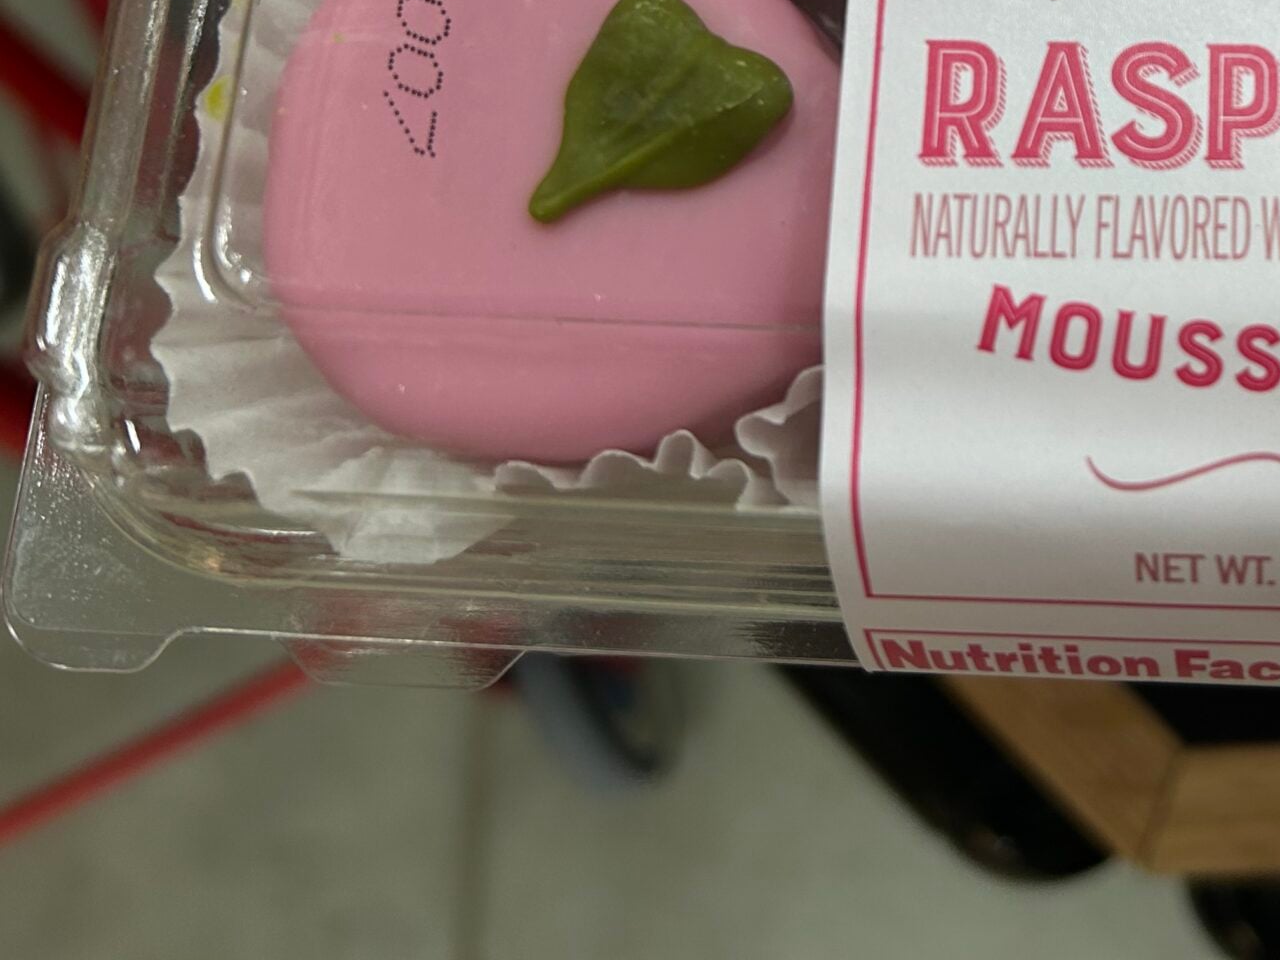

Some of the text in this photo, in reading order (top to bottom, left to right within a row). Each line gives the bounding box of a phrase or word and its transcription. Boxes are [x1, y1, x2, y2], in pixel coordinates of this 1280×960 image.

[910, 192, 1087, 261] NATURALLY
[1096, 195, 1252, 262] FLAVORED
[1134, 553, 1203, 585] NET
[1216, 555, 1276, 586] WT.
[879, 639, 1173, 678] Nutrition
